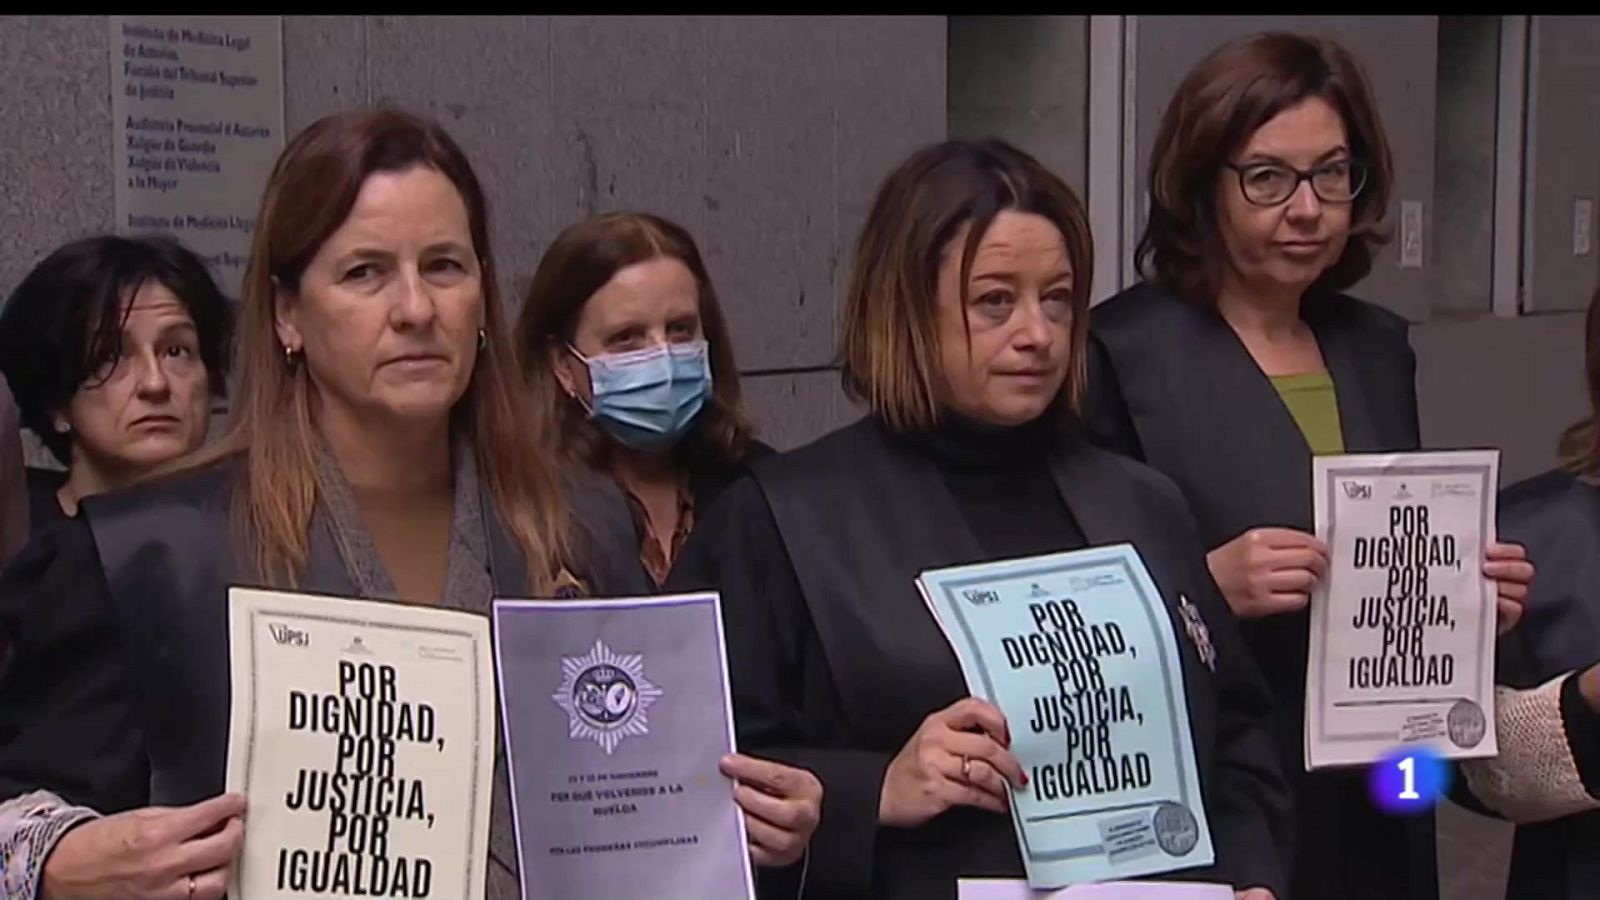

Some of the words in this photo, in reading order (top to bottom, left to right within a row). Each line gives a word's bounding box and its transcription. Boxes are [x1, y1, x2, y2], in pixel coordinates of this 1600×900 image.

[1389, 505, 1429, 537] POR
[1353, 534, 1461, 571] DIGNIDAD,
[1387, 565, 1429, 598] POR
[1029, 598, 1085, 633] POR
[1352, 595, 1456, 631] JUSTICIA,
[1001, 621, 1137, 670] DIGNIDAD,
[1382, 625, 1424, 657] POR
[339, 660, 397, 702] POR
[1053, 658, 1105, 696] POR
[1349, 654, 1455, 689] IGUALDAD
[289, 691, 445, 752] DIGNIDAD,
[1030, 685, 1144, 734] JUSTICIA,
[336, 734, 395, 779] POR
[1066, 723, 1112, 763] POR
[1032, 752, 1152, 802] IGUALDAD
[286, 769, 435, 829] JUSTICIA,
[329, 809, 390, 858] POR
[277, 849, 433, 899] IGUALDAD
